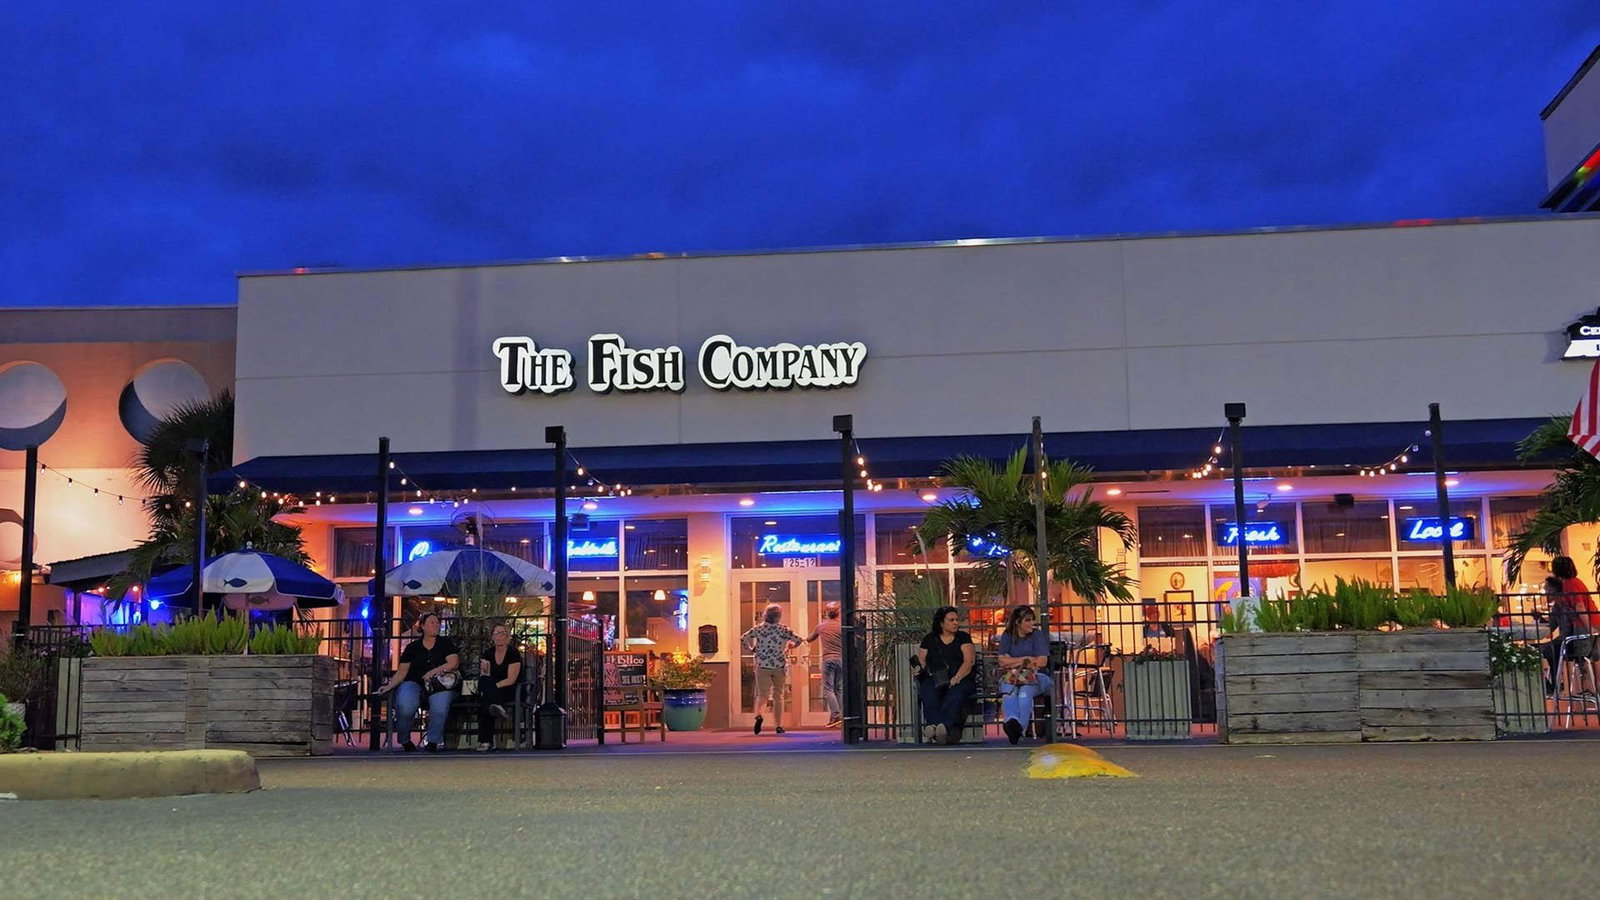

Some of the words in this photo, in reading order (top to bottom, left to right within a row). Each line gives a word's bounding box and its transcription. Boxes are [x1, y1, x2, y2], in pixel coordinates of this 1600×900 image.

[495, 338, 572, 389] THE
[588, 336, 684, 389] FISH
[700, 336, 864, 387] COMPANY
[1227, 527, 1280, 543] Fesh
